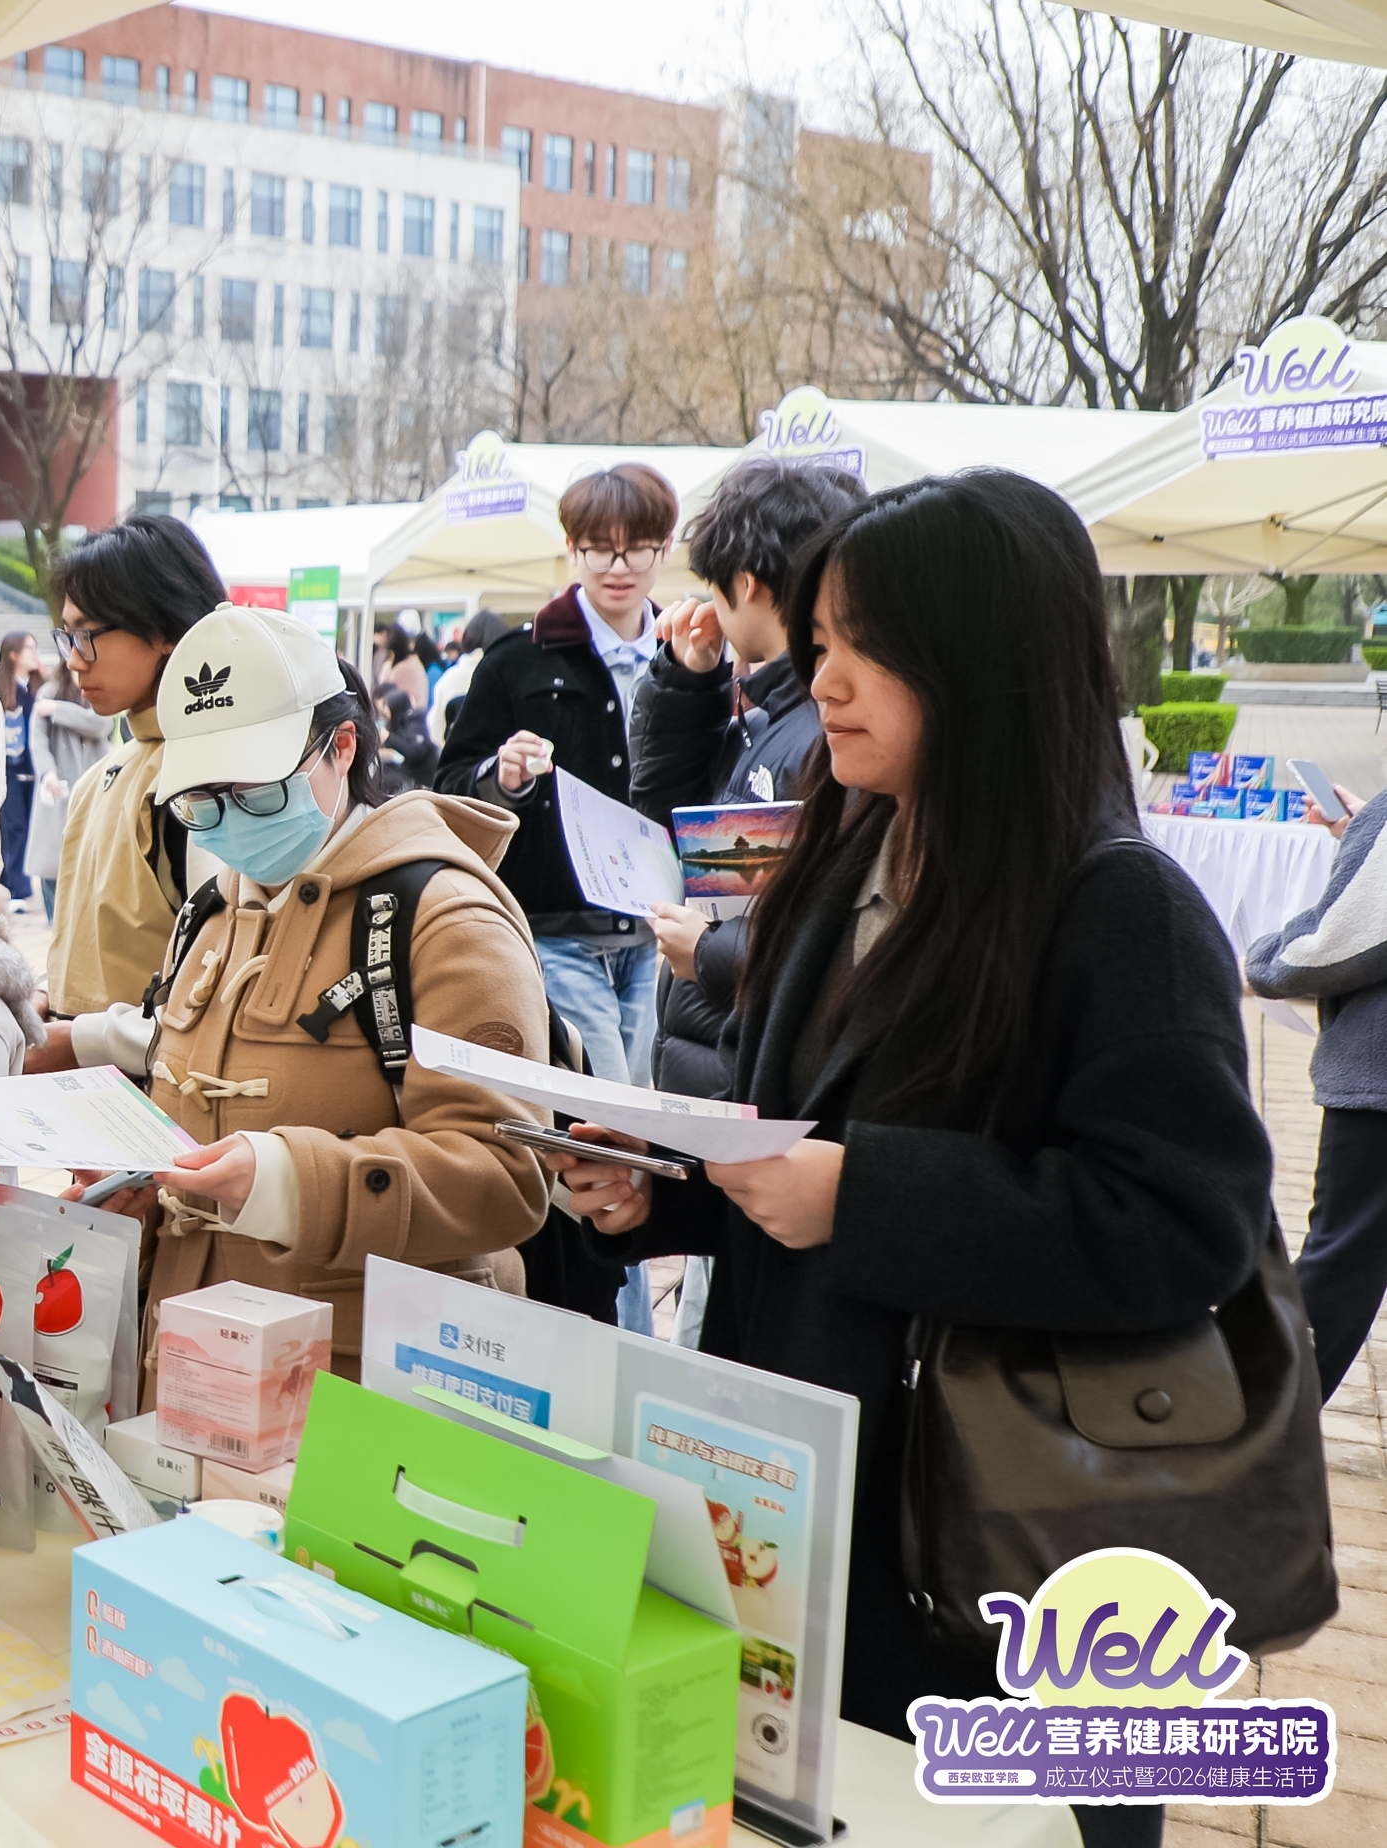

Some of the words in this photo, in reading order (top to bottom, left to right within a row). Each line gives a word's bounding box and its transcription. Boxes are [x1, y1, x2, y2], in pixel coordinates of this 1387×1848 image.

[1240, 344, 1356, 396] Well
[765, 409, 835, 450] Well
[1205, 408, 1257, 437] Well
[184, 695, 234, 715] adidas
[462, 1333, 505, 1362] 支付宝
[85, 1730, 242, 1848] 金银花苹果汁
